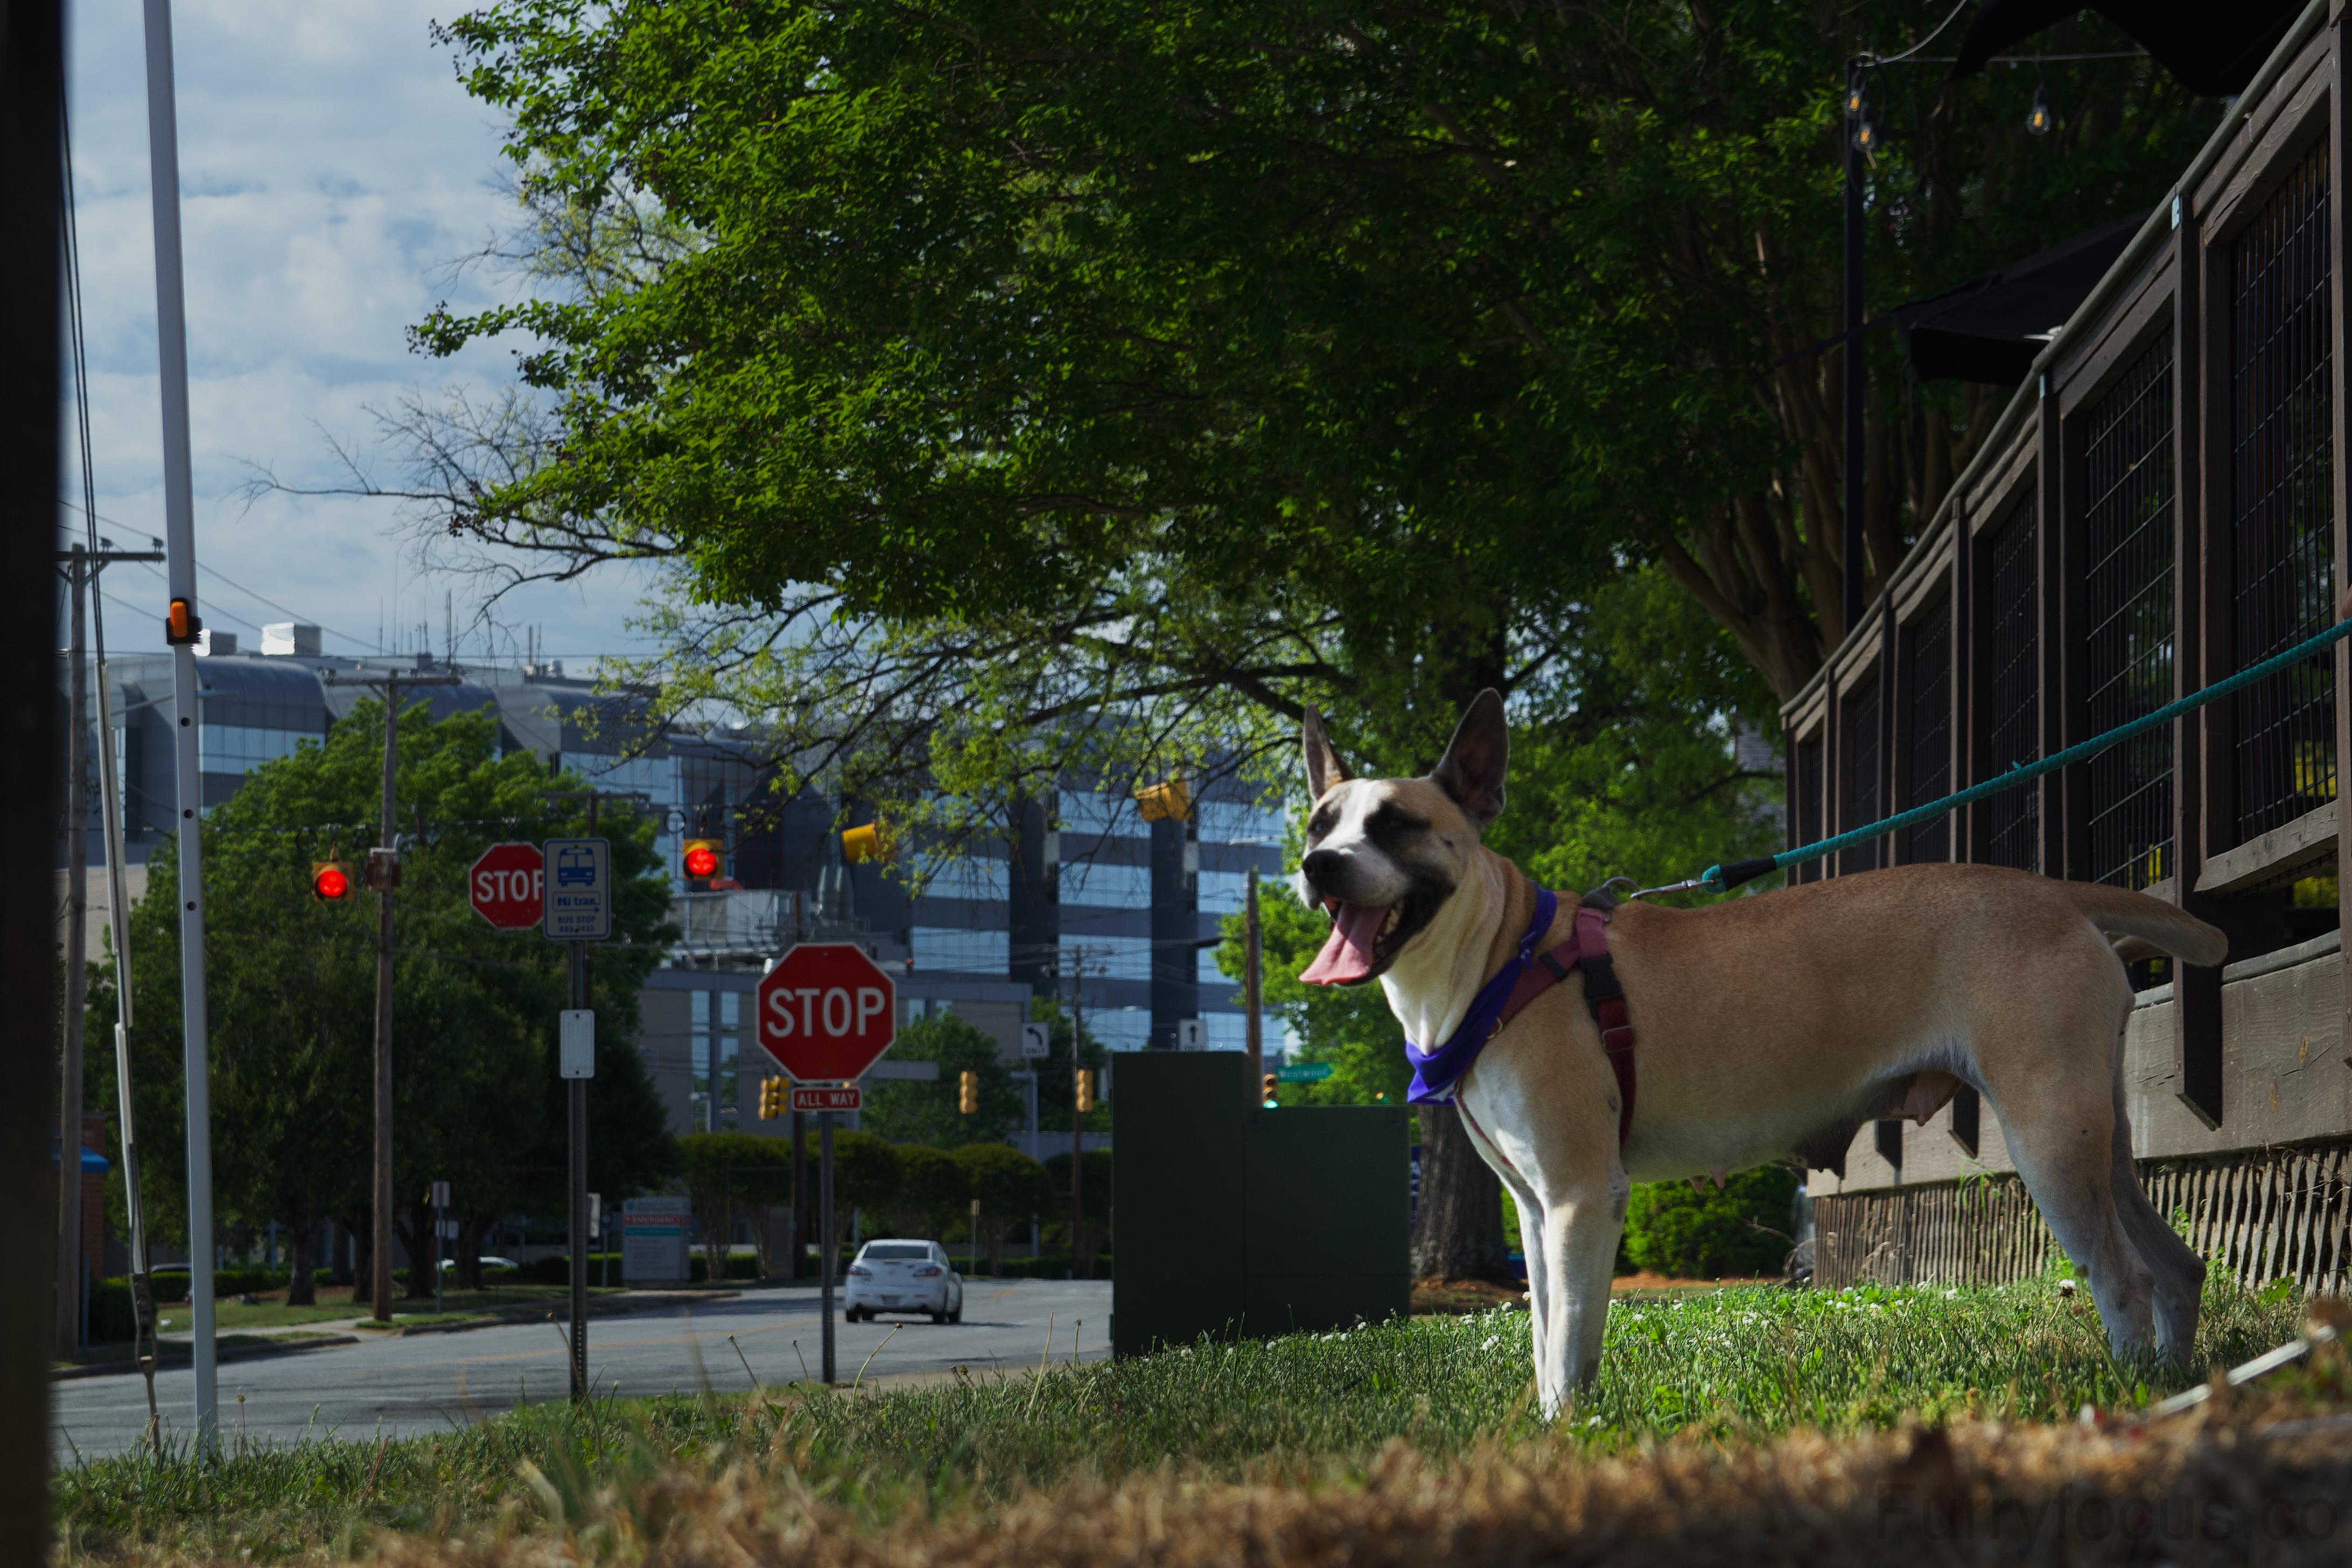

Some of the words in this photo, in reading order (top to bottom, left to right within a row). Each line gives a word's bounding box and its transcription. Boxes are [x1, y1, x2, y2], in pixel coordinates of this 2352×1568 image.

[767, 986, 885, 1038] STOP
[799, 1092, 823, 1107] ALL
[829, 1092, 856, 1107] WAY
